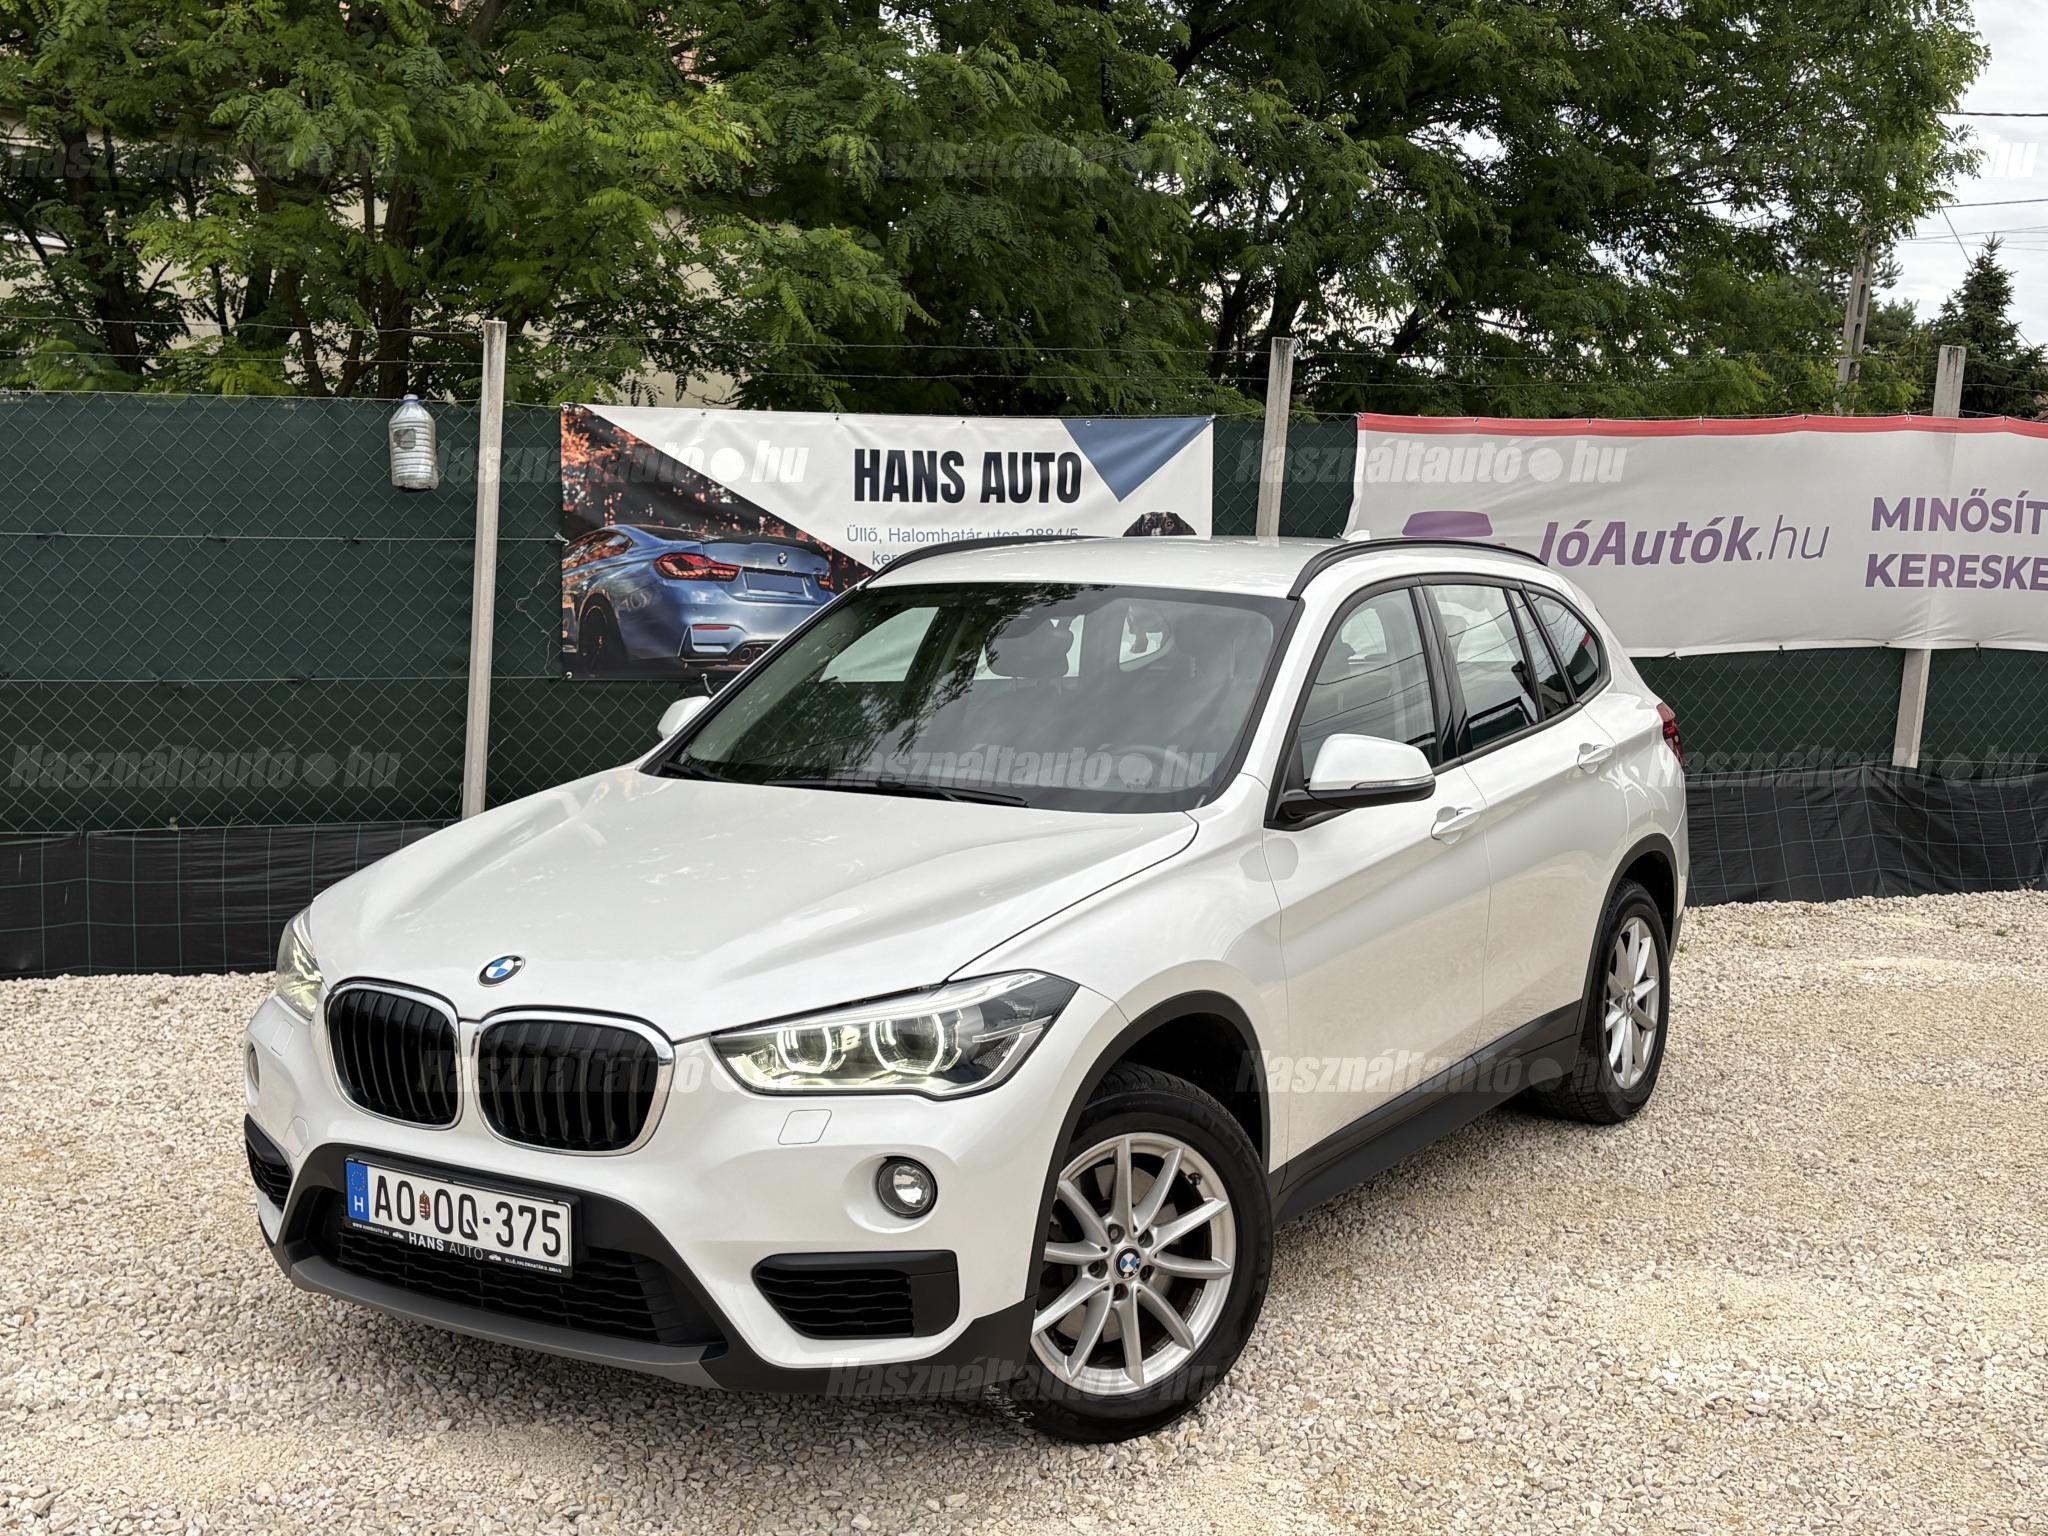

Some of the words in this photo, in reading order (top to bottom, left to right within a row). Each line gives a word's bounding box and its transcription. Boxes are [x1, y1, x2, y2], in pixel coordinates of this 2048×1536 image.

[853, 448, 966, 503] HANS
[980, 451, 1083, 504] AUTO
[846, 524, 883, 544] Üllő,
[888, 526, 982, 543] Halomhatár
[1865, 553, 2048, 592] KERESKE
[353, 1195, 365, 1213] H
[408, 1231, 445, 1252] HANS
[449, 1241, 484, 1261] AUTO
